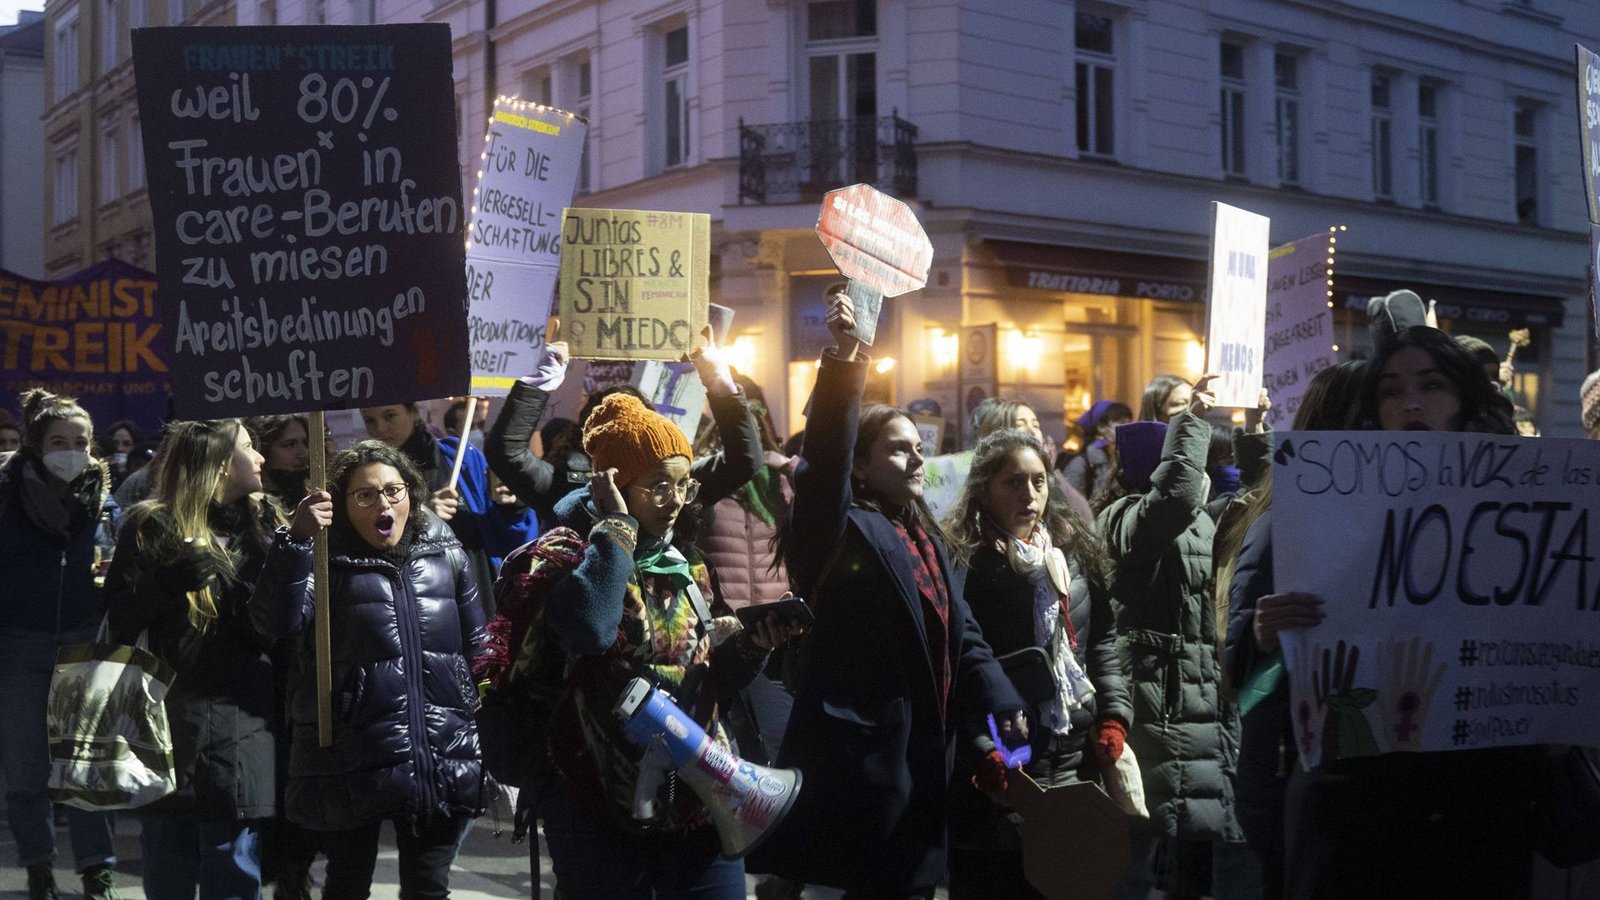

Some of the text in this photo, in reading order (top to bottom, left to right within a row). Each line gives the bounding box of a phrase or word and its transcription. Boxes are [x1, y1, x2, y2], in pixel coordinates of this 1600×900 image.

[171, 72, 399, 129] weil 80%
[358, 131, 401, 186] in
[487, 131, 551, 181] FÜR DIE
[473, 219, 561, 257] SCHAFTUNG
[566, 213, 684, 245] Juntas #8M
[182, 232, 388, 289] zu miesen
[580, 246, 685, 278] LIBRES &
[574, 278, 630, 314] SIN
[1028, 271, 1121, 295] TRATTORIA
[1136, 281, 1194, 301] PORTO
[596, 316, 693, 351] MIEDO
[203, 348, 375, 403] schuften
[470, 349, 519, 375] RBEIT
[1296, 440, 1428, 497] SOMOS
[1459, 440, 1520, 489] VOZ
[1519, 446, 1550, 488] de
[1369, 501, 1600, 611] NO ESTA
